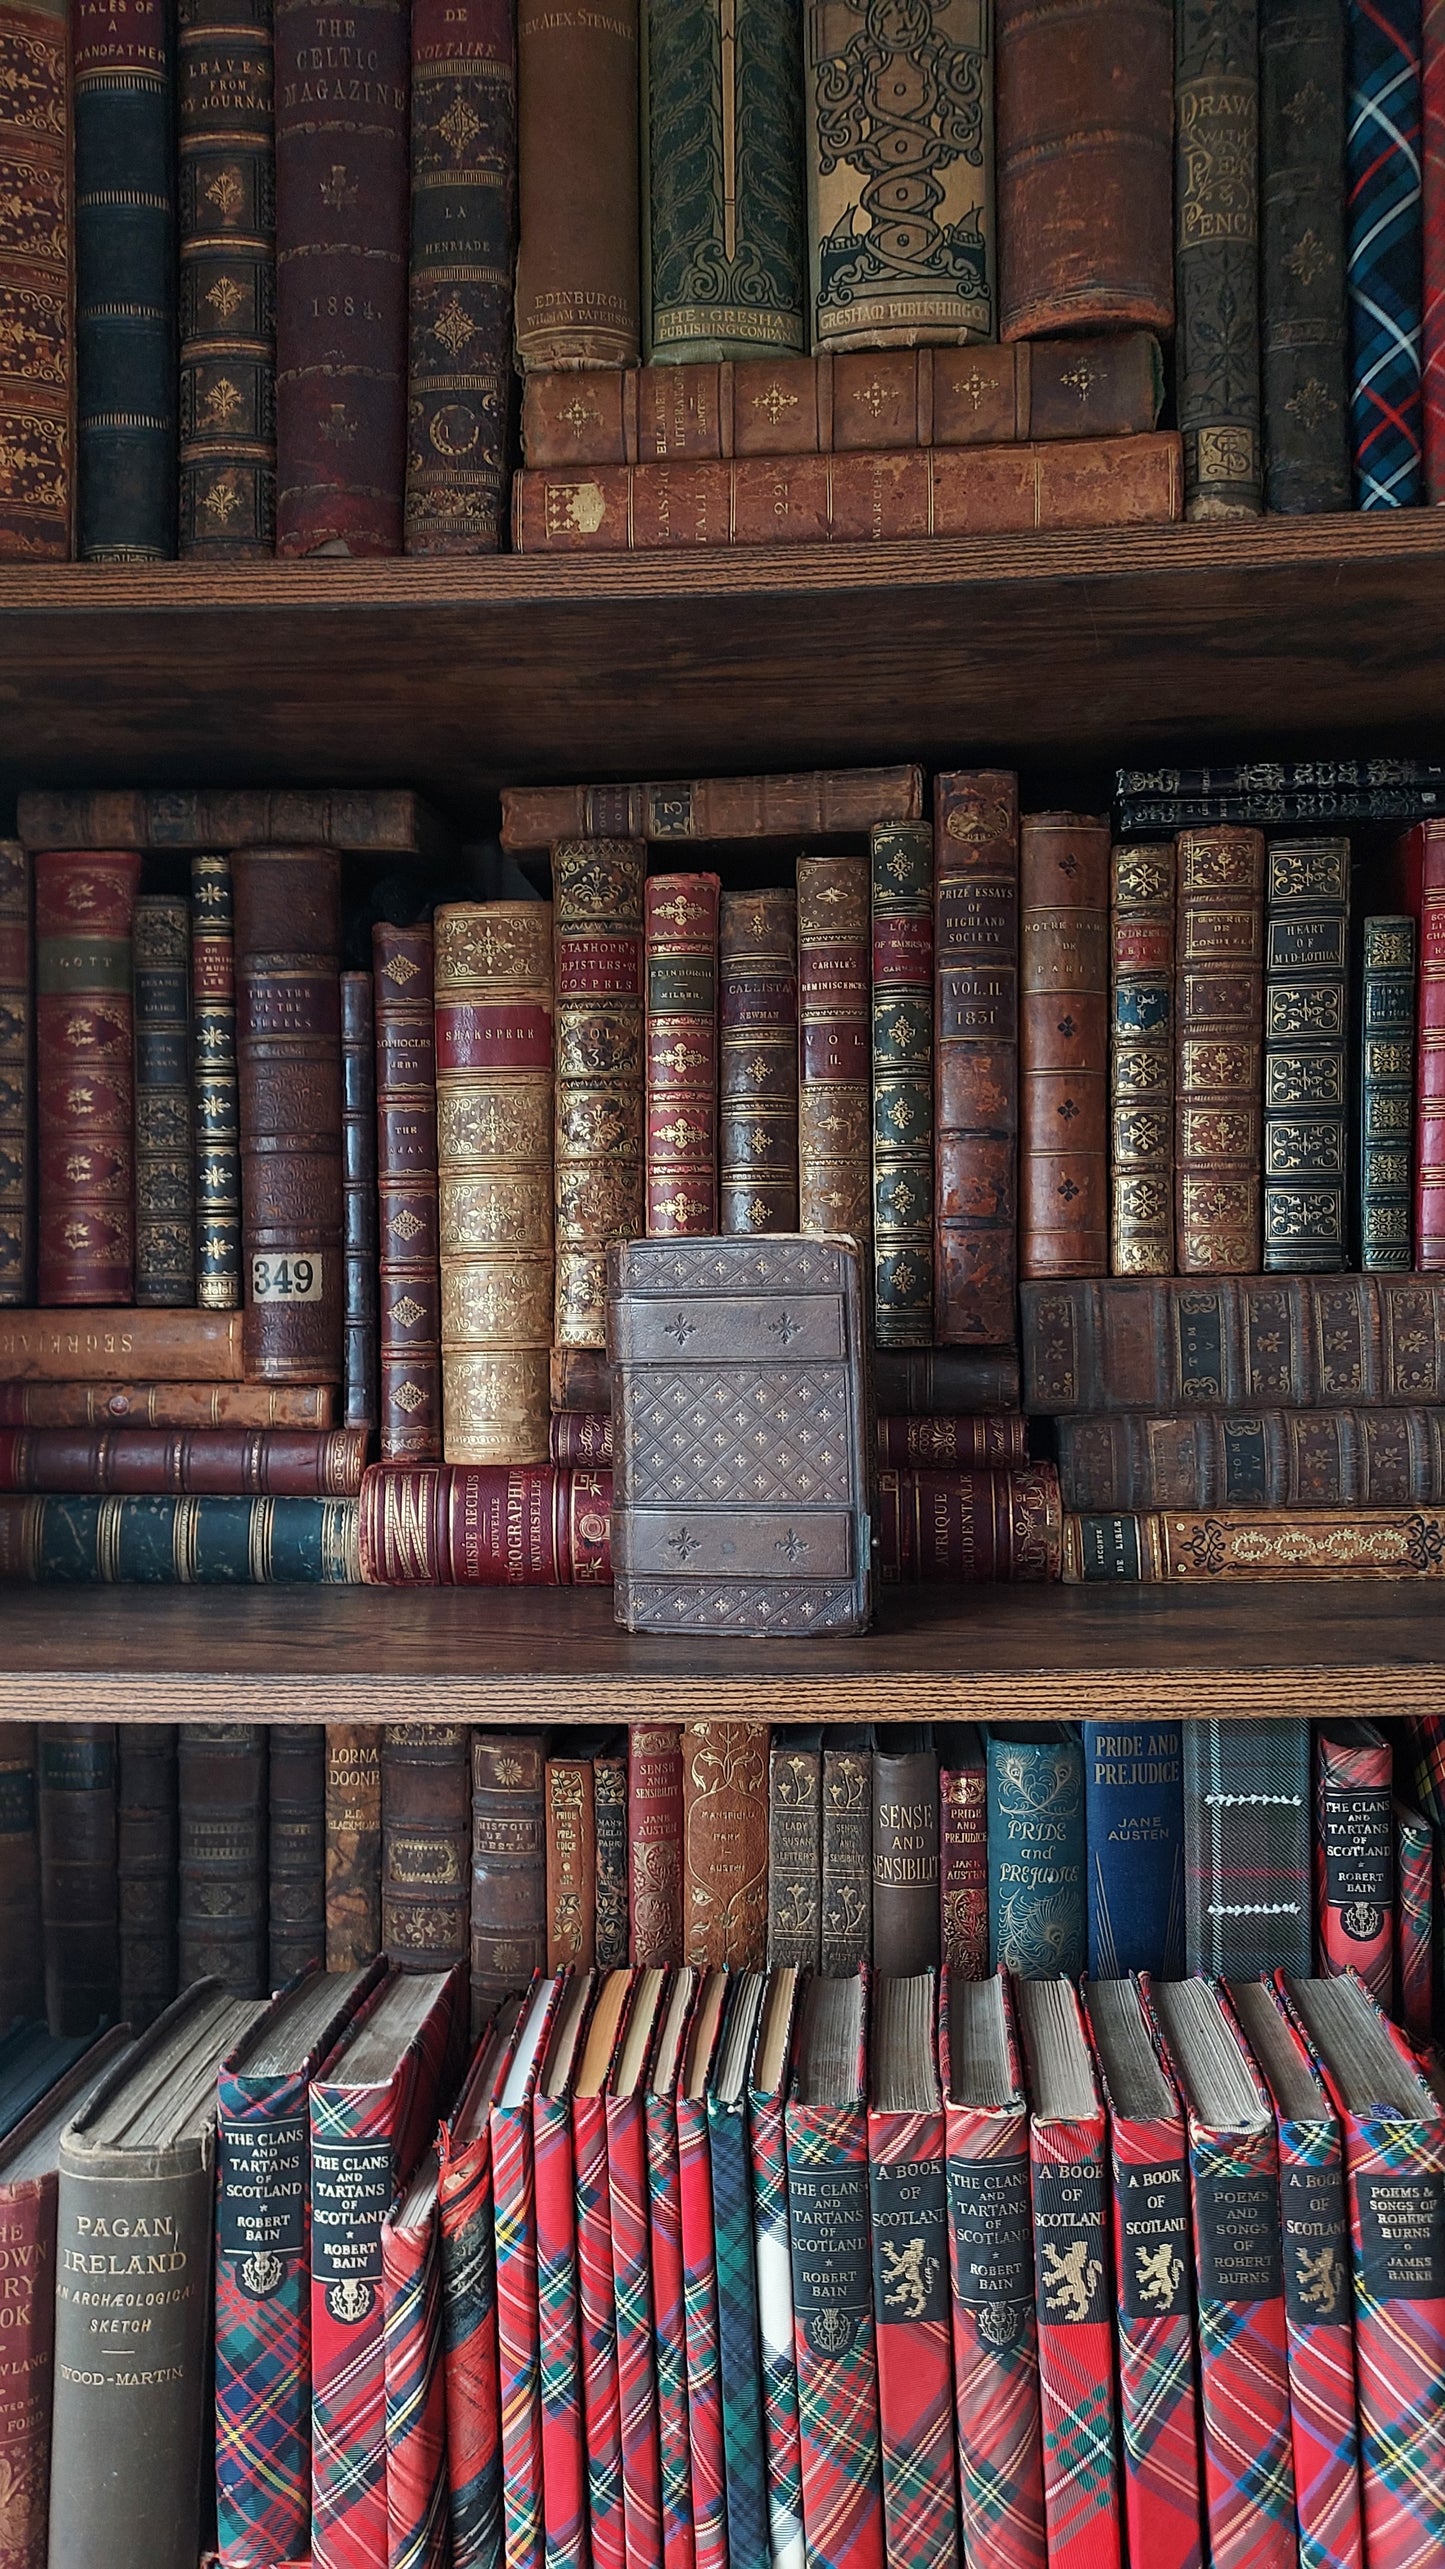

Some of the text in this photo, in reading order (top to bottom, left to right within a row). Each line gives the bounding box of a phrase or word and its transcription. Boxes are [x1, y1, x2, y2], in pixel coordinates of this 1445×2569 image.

[80, 0, 155, 16] TALES OF
[445, 9, 467, 22] DE
[108, 20, 118, 32] A
[316, 19, 357, 38] THE
[416, 41, 497, 60] VOLTAIRE
[296, 47, 379, 71] CELTIC
[190, 60, 266, 77] LEAVES
[210, 81, 247, 92] FROM
[284, 79, 406, 111] MAGAZINE
[202, 95, 274, 112] JOURNAL
[445, 206, 467, 219] LA
[425, 241, 491, 255] HENRIADE
[535, 291, 628, 311] EDINBURGH
[526, 309, 573, 327] WILLIAM
[659, 308, 696, 328] THE
[660, 322, 736, 340] PUBLISHING
[939, 887, 1014, 900] PRIZE ESSAYS
[968, 903, 983, 913] OF
[946, 918, 1006, 929] HIGHLAND
[1024, 920, 1067, 933] NOTRE
[1286, 923, 1326, 936] HEART
[949, 931, 1001, 943] SOCIETY
[1296, 938, 1314, 949] OF
[874, 941, 887, 950] OF
[1061, 942, 1077, 951] DE
[650, 968, 713, 978] EDINBURGH
[729, 983, 792, 995] CALLISTA
[739, 1011, 780, 1020] NEWMAN
[956, 1011, 996, 1026] 1831
[445, 1028, 535, 1041] SHAKSPERE
[376, 1038, 432, 1049] SOPHOCLES
[254, 1259, 314, 1295] 349
[466, 1474, 480, 1527] RECLUS
[489, 1496, 502, 1558] NOUVELLE
[530, 1479, 542, 1572] UNIVERSELLE
[933, 1492, 951, 1568] AFRIQUE
[1116, 1558, 1125, 1573] DE
[1095, 1733, 1178, 1757] PRIDE AND
[329, 1747, 379, 1764] LORNA
[639, 1763, 676, 1775] SENSE
[1093, 1760, 1179, 1785] PREJUDICE
[329, 1769, 381, 1786] DOONE
[646, 1776, 668, 1787] AND
[634, 1785, 681, 1800] SENSIBILITY
[1325, 1800, 1391, 1814] THE CLANS
[642, 1815, 670, 1825] JANE
[879, 1803, 934, 1830] SENSE
[950, 1808, 983, 1820] PRIDE
[1347, 1814, 1371, 1822] AND
[784, 1821, 808, 1832] LADY
[835, 1822, 859, 1833] SENSE
[955, 1821, 977, 1831] AND
[1117, 1815, 1162, 1828] JANE
[638, 1823, 680, 1837] AUSTEN
[1007, 1819, 1067, 1841] PRIDE
[1107, 1828, 1170, 1841] AUSTEN
[1328, 1823, 1390, 1836] TARTANS
[782, 1835, 812, 1847] SUSAN
[890, 1835, 925, 1850] AND
[944, 1831, 987, 1844] PREJUDICE
[1351, 1836, 1368, 1846] OF
[777, 1850, 815, 1862] LETTERS
[1020, 1844, 1056, 1860] and
[1326, 1845, 1391, 1858] SCOTLAND
[946, 1868, 987, 1881] AUSTEN
[999, 1862, 1080, 1890] PREJUDICE
[1337, 1872, 1385, 1883] ROBERT
[1346, 1883, 1376, 1894] BAIN
[225, 2130, 304, 2147] THE CLANS
[251, 2148, 278, 2158] AND
[229, 2156, 300, 2172] TARTANS
[313, 2154, 389, 2171] THE CLANS
[876, 2160, 943, 2181] A BOOK
[1039, 2164, 1104, 2180] A BOOK
[255, 2175, 272, 2184] OF
[336, 2172, 364, 2183] AND
[951, 2170, 1029, 2190] THE CLANS
[1127, 2169, 1183, 2188] A BOOK
[1289, 2173, 1303, 2188] A
[226, 2182, 303, 2198] SCOTLAND
[316, 2183, 386, 2199] TARTANS
[789, 2181, 817, 2197] THE
[899, 2187, 922, 2201] OF
[1061, 2188, 1083, 2202] OF
[1370, 2186, 1434, 2199] POEMS &
[978, 2191, 1006, 2202] AND
[1146, 2195, 1166, 2209] OF
[1213, 2191, 1270, 2204] POEMS
[341, 2200, 358, 2210] OF
[813, 2200, 841, 2209] AND
[957, 2200, 1028, 2217] TARTANS
[1309, 2198, 1331, 2212] OF
[1369, 2199, 1438, 2212] SONGS OF
[313, 2208, 388, 2226] SCOTLAND
[793, 2209, 865, 2226] TARTANS
[1226, 2207, 1259, 2220] AND
[1377, 2213, 1434, 2225] ROBERT
[76, 2214, 173, 2239] PAGAN
[236, 2214, 291, 2228] ROBERT
[984, 2219, 1002, 2230] OF
[245, 2229, 281, 2241] BAIN
[819, 2227, 837, 2238] OF
[1216, 2223, 1270, 2236] SONGS
[1381, 2226, 1431, 2239] BURNS
[956, 2228, 1032, 2245] SCOTLAND
[322, 2242, 378, 2255] ROBERT
[790, 2237, 868, 2254] SCOTLAND
[1233, 2239, 1254, 2252] OF
[63, 2248, 188, 2276] IRELAND
[332, 2256, 369, 2269] BAIN
[1213, 2256, 1272, 2269] ROBERT
[1387, 2256, 1433, 2268] JAMES
[969, 2262, 1023, 2276] ROBERT
[801, 2270, 857, 2285] ROBERT
[1218, 2272, 1271, 2285] BURNS
[979, 2278, 1014, 2291] BAIN
[55, 2283, 69, 2300] AN
[811, 2286, 848, 2298] BAIN
[89, 2318, 153, 2334] SKETCH
[12, 2351, 48, 2376] LANG
[60, 2363, 185, 2387] WOOD-MARTIN
[7, 2410, 45, 2434] FORD
